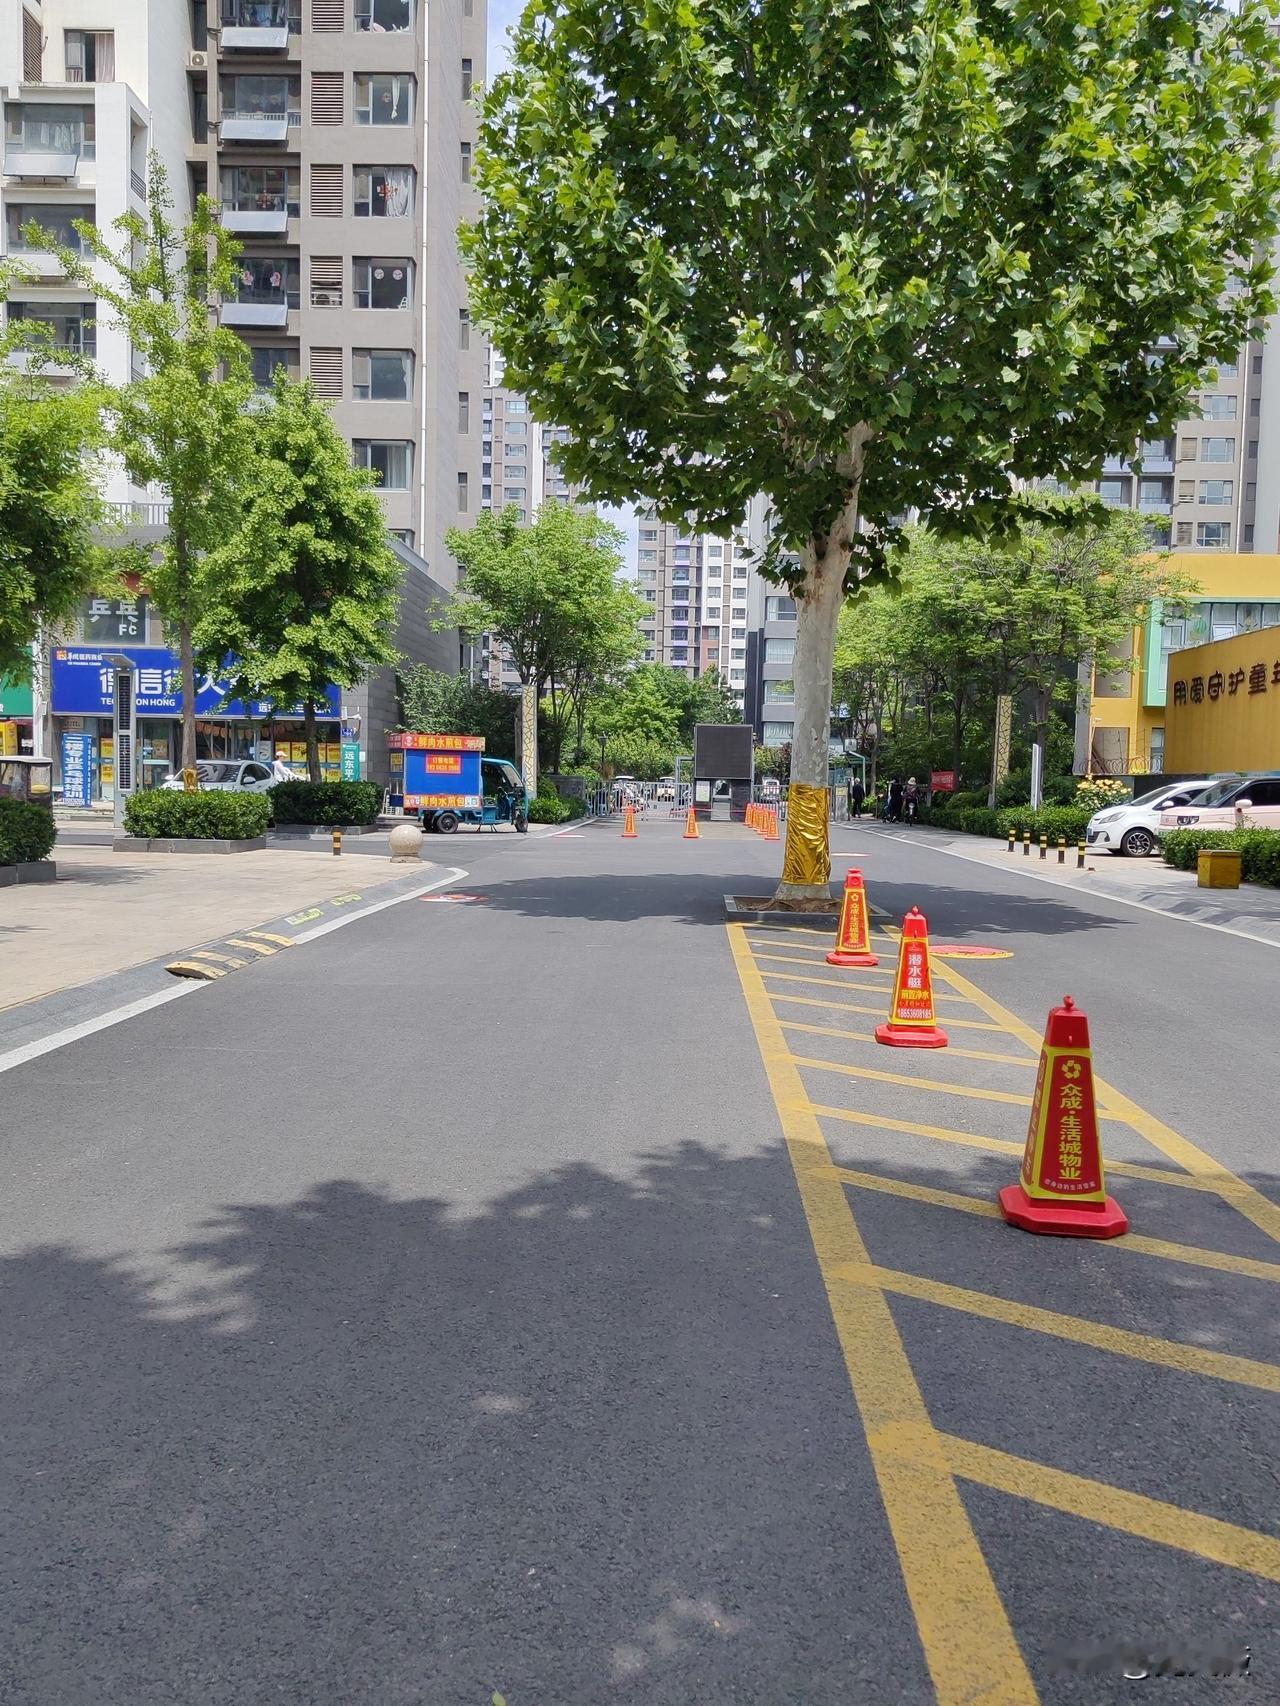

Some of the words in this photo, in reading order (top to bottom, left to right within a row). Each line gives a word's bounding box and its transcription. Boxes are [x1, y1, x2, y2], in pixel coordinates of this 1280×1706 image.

[118, 624, 137, 636] FC
[150, 698, 176, 707] HONG
[418, 736, 463, 749] 鲜肉水煎包
[420, 796, 465, 807] 鲜肉水煎包
[907, 954, 922, 988] 潜水艇
